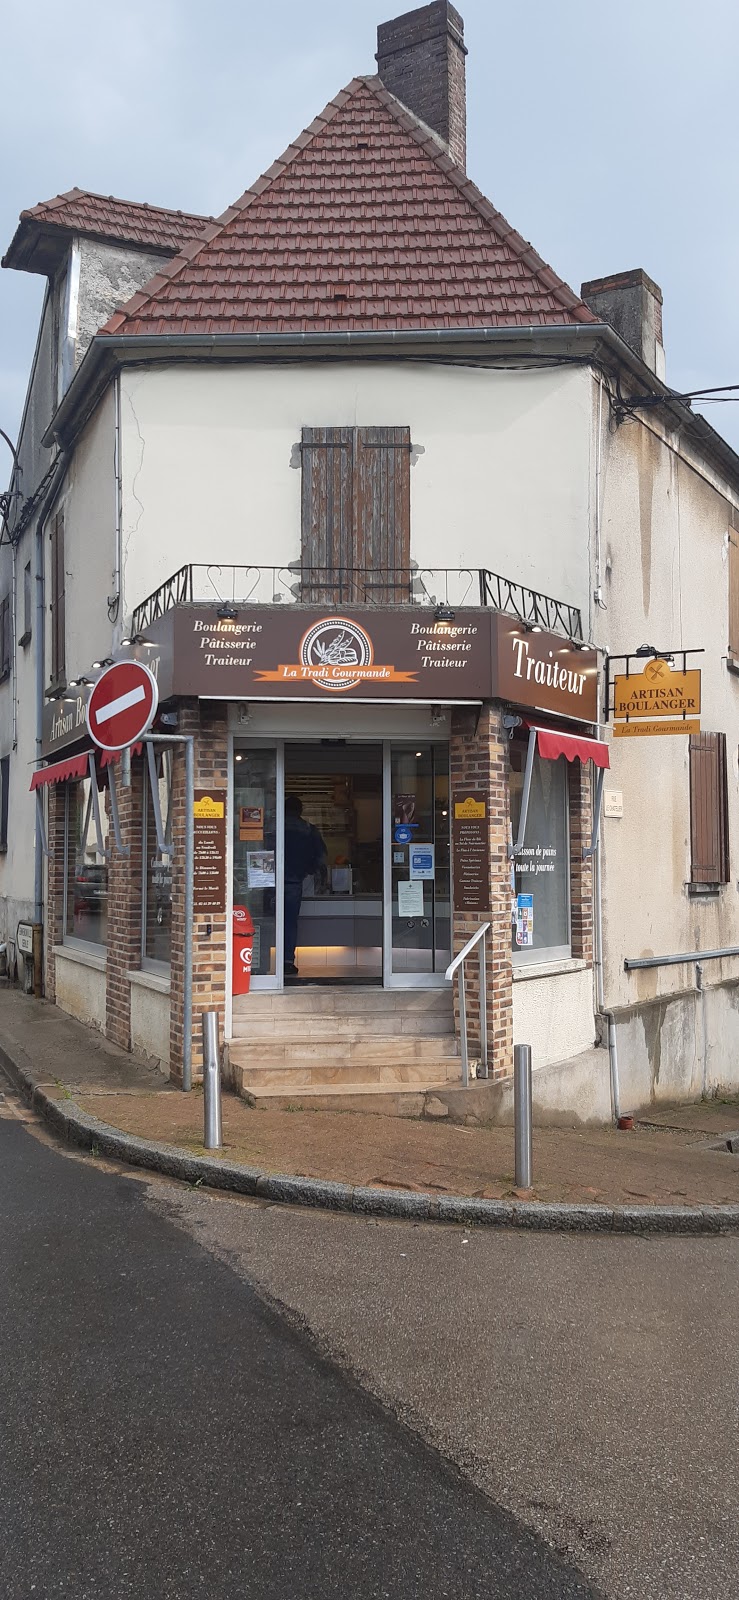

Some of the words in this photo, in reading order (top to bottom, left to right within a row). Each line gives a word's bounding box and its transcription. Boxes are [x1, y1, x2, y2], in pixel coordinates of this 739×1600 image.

[193, 620, 263, 636] Boulangerie
[410, 622, 478, 638] Boulangerie
[199, 637, 257, 649] Pâtisserie
[416, 639, 472, 651] Pâtisserie
[204, 653, 253, 666] Traiteur
[421, 656, 468, 668] Traiteur
[283, 666, 297, 677] La
[301, 666, 329, 678] Tradi
[332, 667, 391, 678] Gourmande
[512, 637, 587, 696] Traiteur
[630, 687, 684, 700] ARTISAN
[619, 698, 696, 712] BOULANGER
[50, 709, 73, 742] Artisan
[621, 726, 631, 734] La
[633, 725, 651, 733] Tradi
[653, 723, 693, 733] Gourmande
[535, 844, 542, 856] de
[542, 845, 557, 860] pains
[515, 862, 530, 872] toute
[529, 860, 536, 872] la
[535, 860, 555, 876] journée
